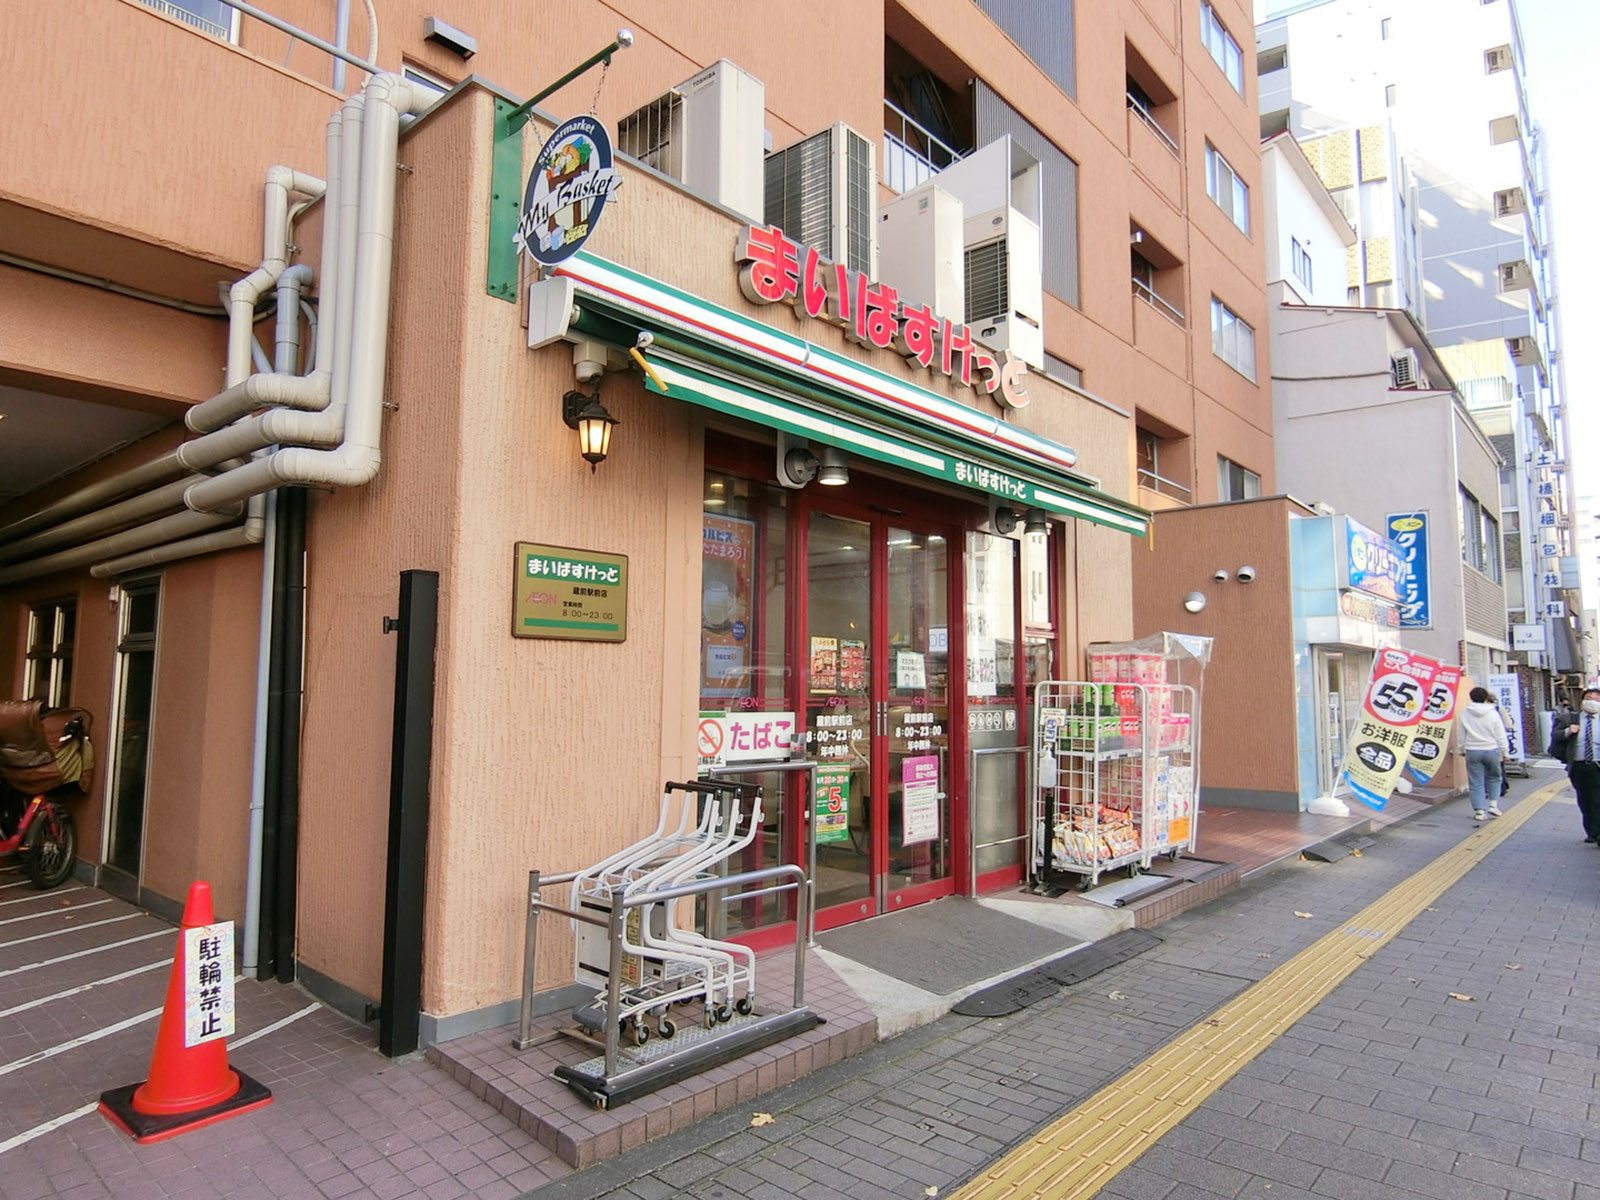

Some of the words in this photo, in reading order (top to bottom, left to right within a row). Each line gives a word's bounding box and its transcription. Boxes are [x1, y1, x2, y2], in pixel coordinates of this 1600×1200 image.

[538, 119, 595, 167] Supermarket
[517, 201, 550, 238] My
[557, 170, 614, 207] Basket
[746, 223, 1030, 410] まいばすけっと
[955, 461, 1026, 499] まいばすけっと
[528, 558, 619, 582] まいばすけっと
[730, 720, 791, 751] たばこ
[1361, 722, 1408, 748] お洋服
[1411, 741, 1437, 757] 全品
[1360, 746, 1394, 770] 全品
[828, 786, 841, 813] 5
[199, 936, 222, 1038] 駐輪禁止
